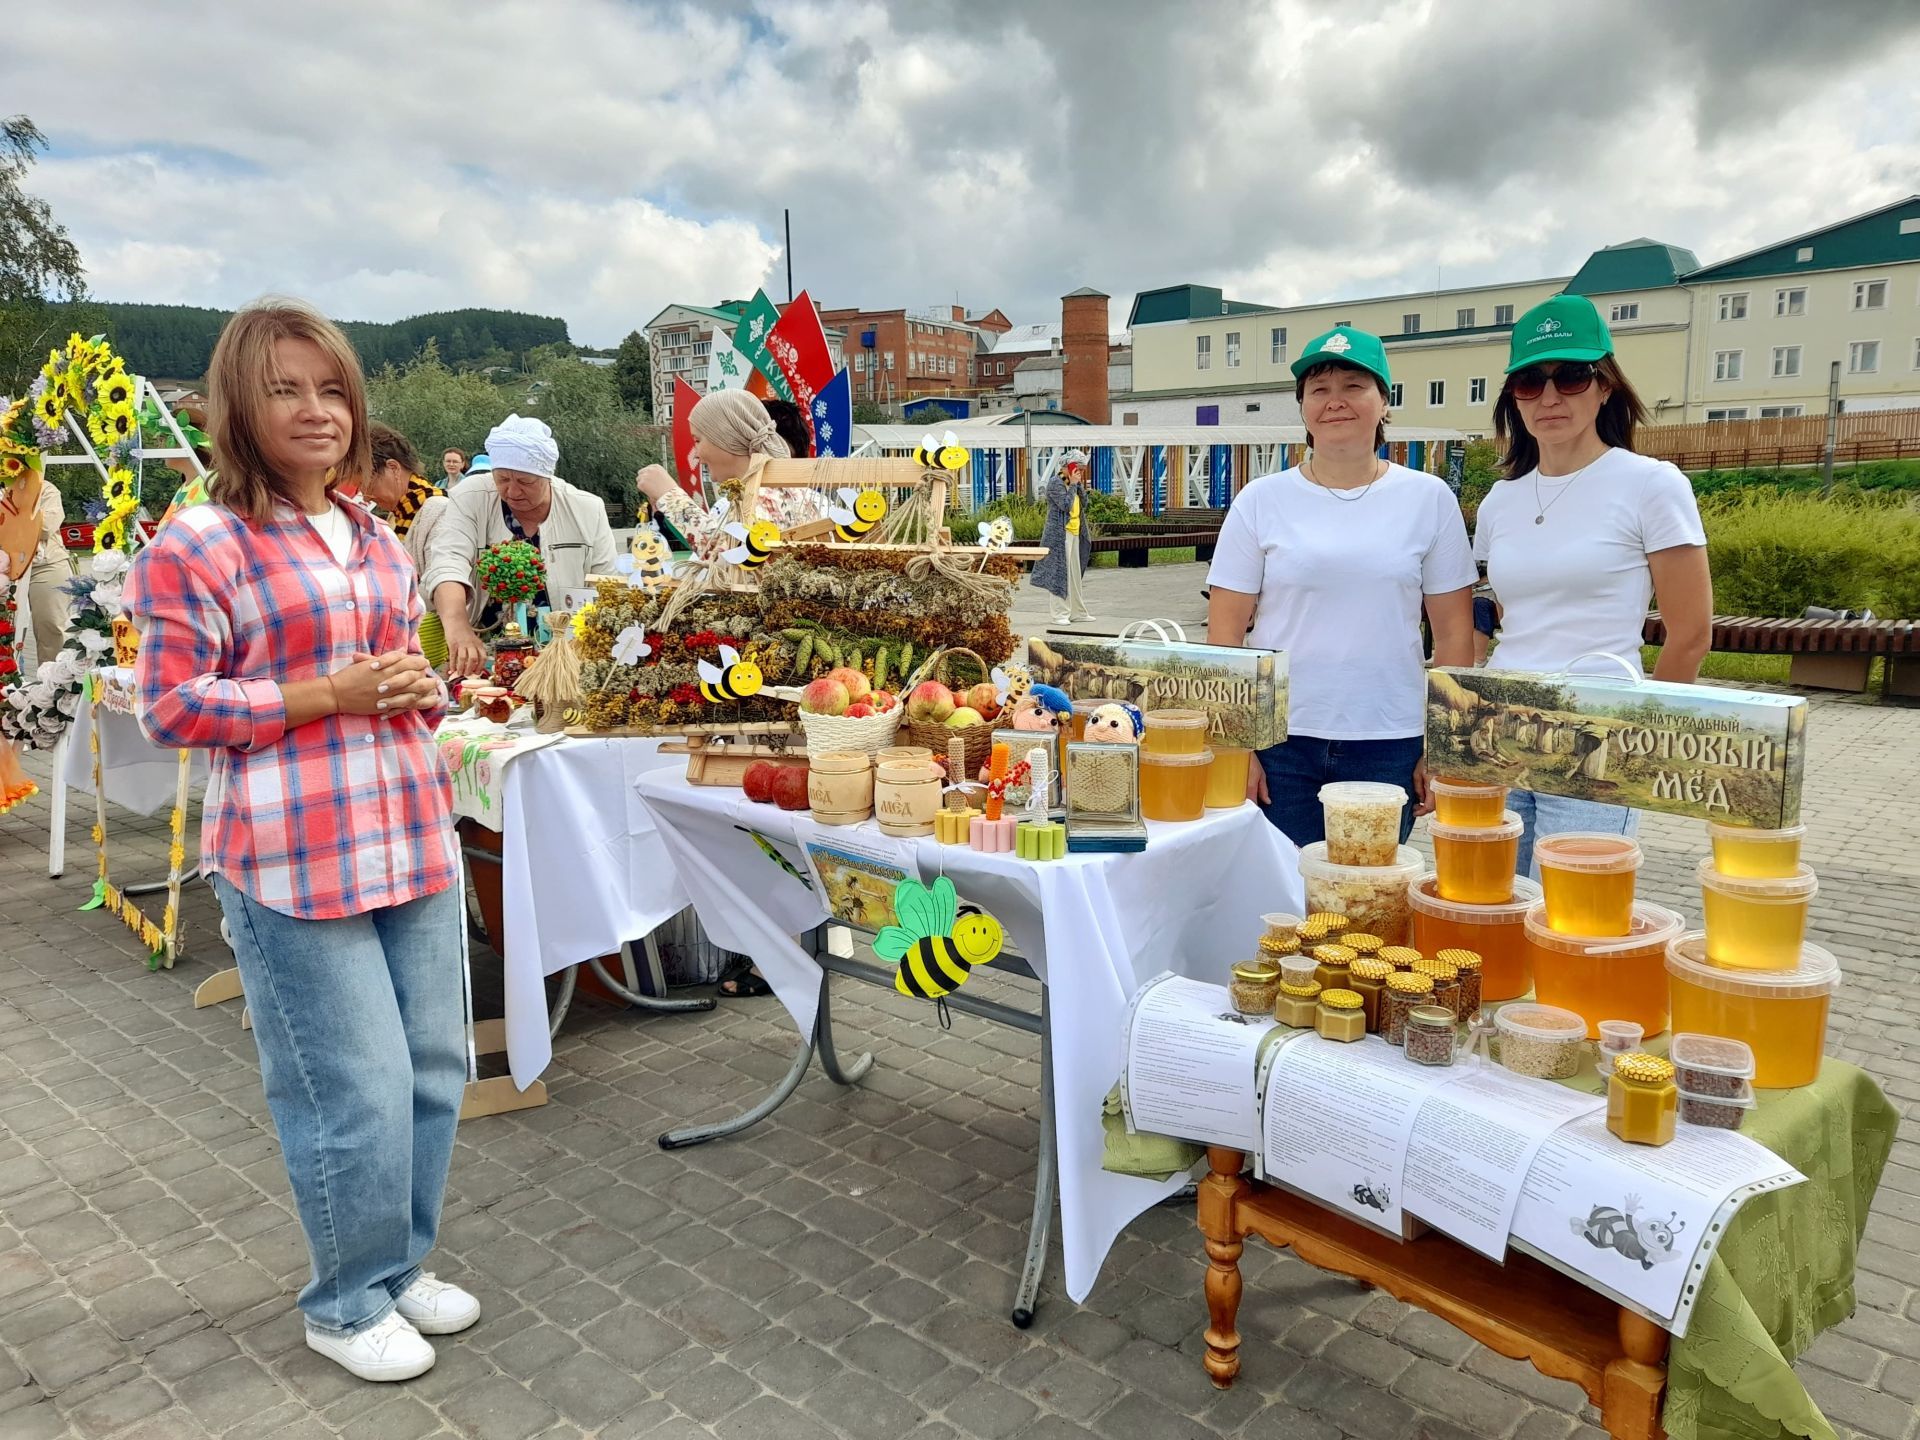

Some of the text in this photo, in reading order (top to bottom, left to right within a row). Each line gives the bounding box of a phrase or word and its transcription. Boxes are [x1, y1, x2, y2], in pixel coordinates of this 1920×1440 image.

[1173, 664, 1230, 678] НАТУРАЛЬНЫЙ
[1154, 676, 1252, 706] СОТОВЫЙ
[1650, 711, 1740, 733] НАТУРАЛЬНЫЙ
[1618, 726, 1776, 772] СОТОВЫЙ
[1652, 768, 1731, 814] МЁД
